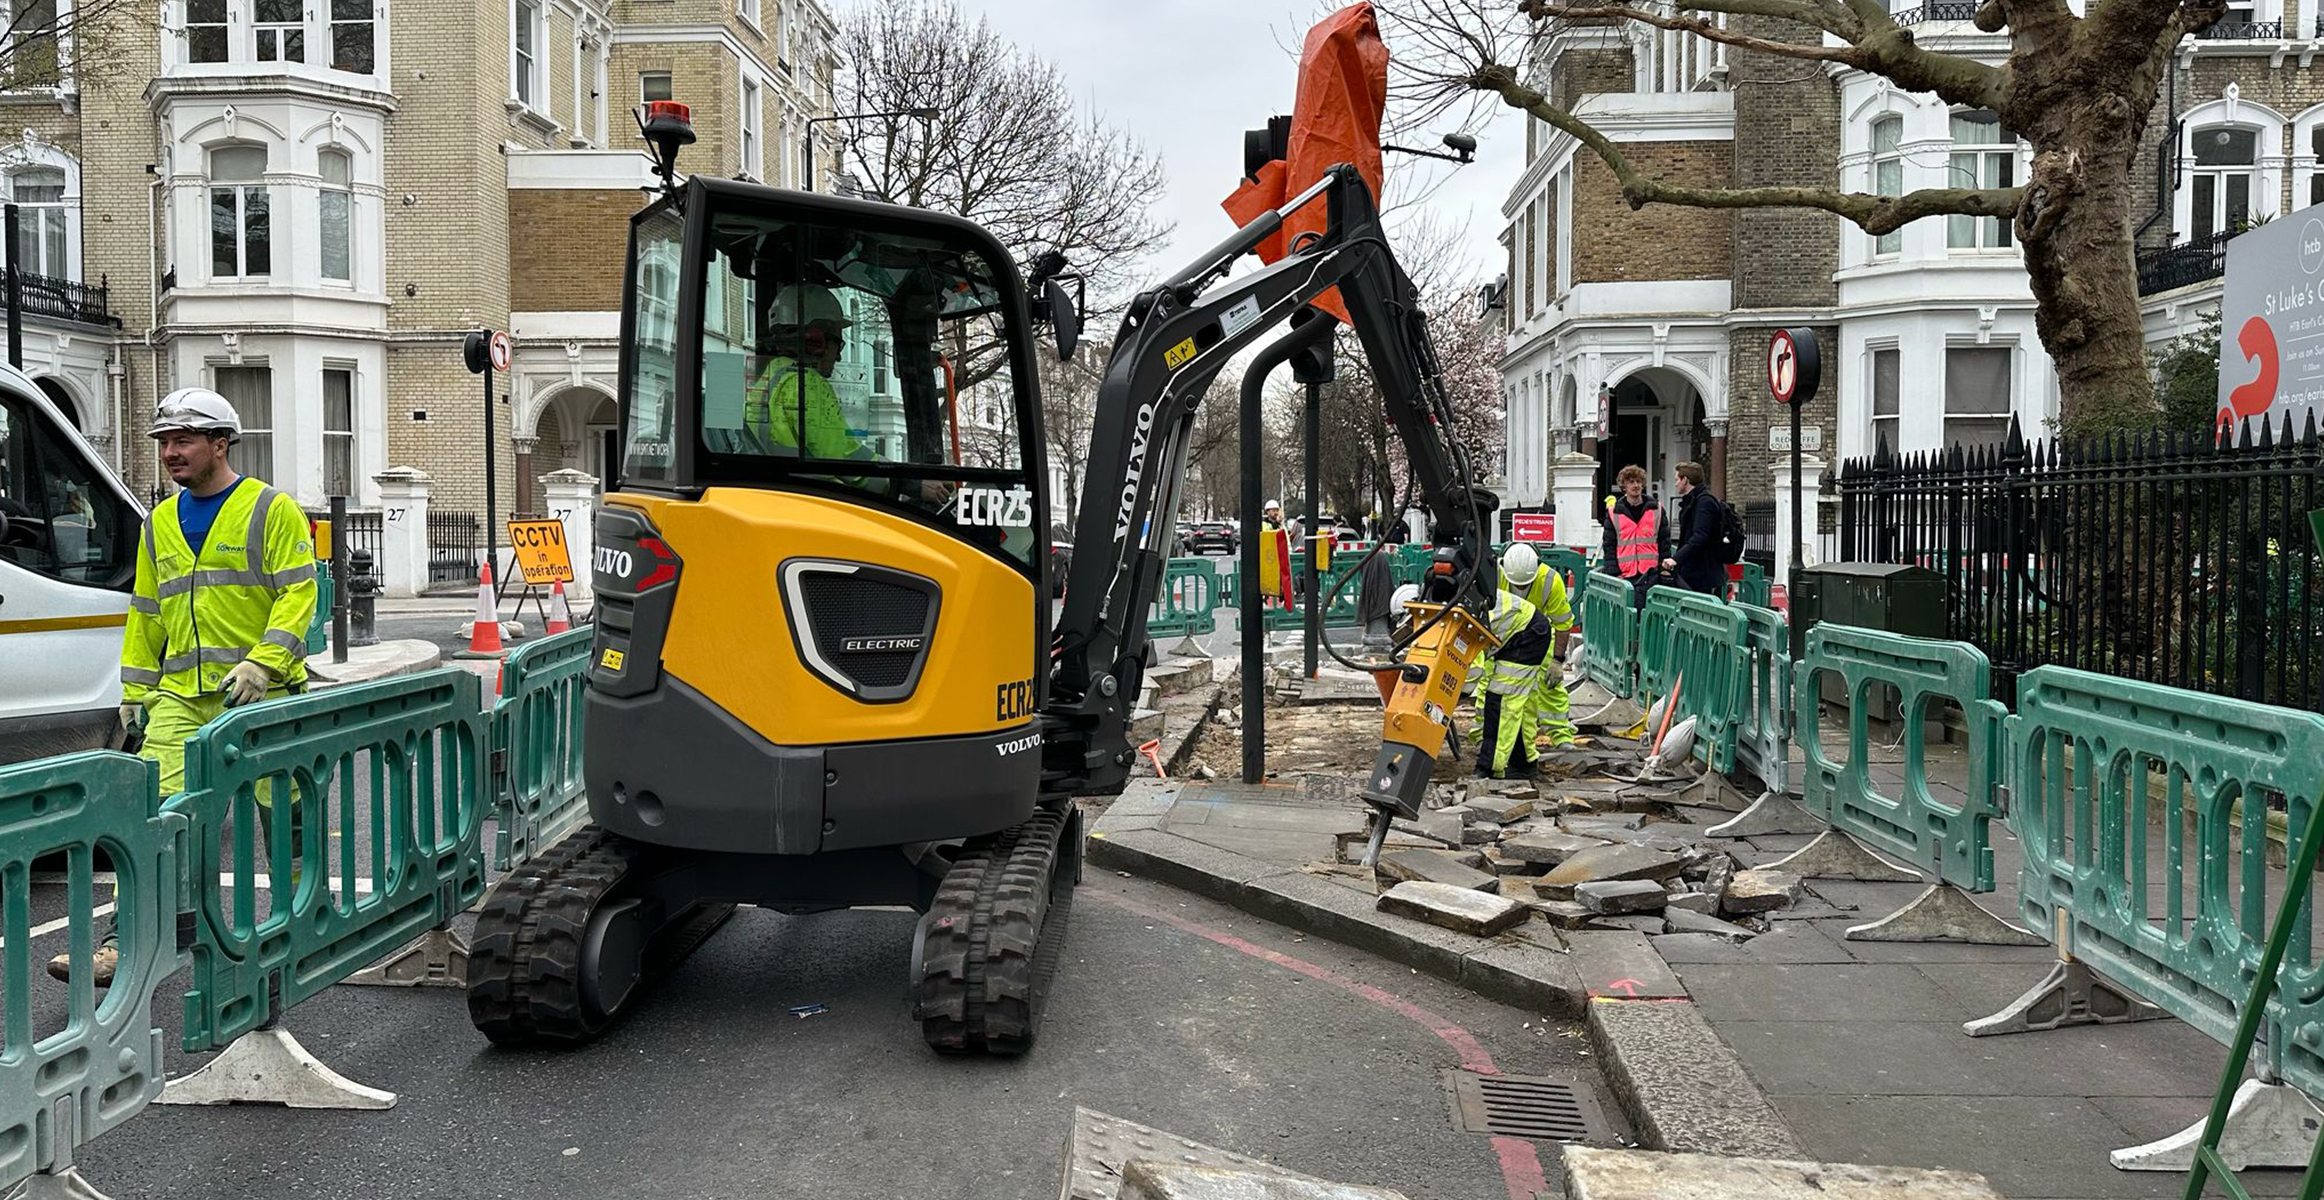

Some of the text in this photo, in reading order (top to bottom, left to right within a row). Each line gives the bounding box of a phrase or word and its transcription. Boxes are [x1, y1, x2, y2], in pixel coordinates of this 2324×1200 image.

[2304, 237, 2321, 256] htb
[2265, 293, 2276, 315] St
[2279, 282, 2314, 312] Luke's
[1113, 403, 1153, 543] VOLVO
[387, 508, 406, 522] 27
[552, 508, 572, 522] 27
[957, 487, 1032, 528] ECR25
[514, 526, 560, 547] CCTV
[216, 542, 246, 553] CONWAY
[537, 550, 548, 562] in
[525, 563, 570, 577] operation
[846, 638, 921, 650] ELECTRIC
[1446, 649, 1468, 671] VOLVO
[997, 679, 1034, 722] ECR2
[996, 733, 1041, 756] VOLVO
